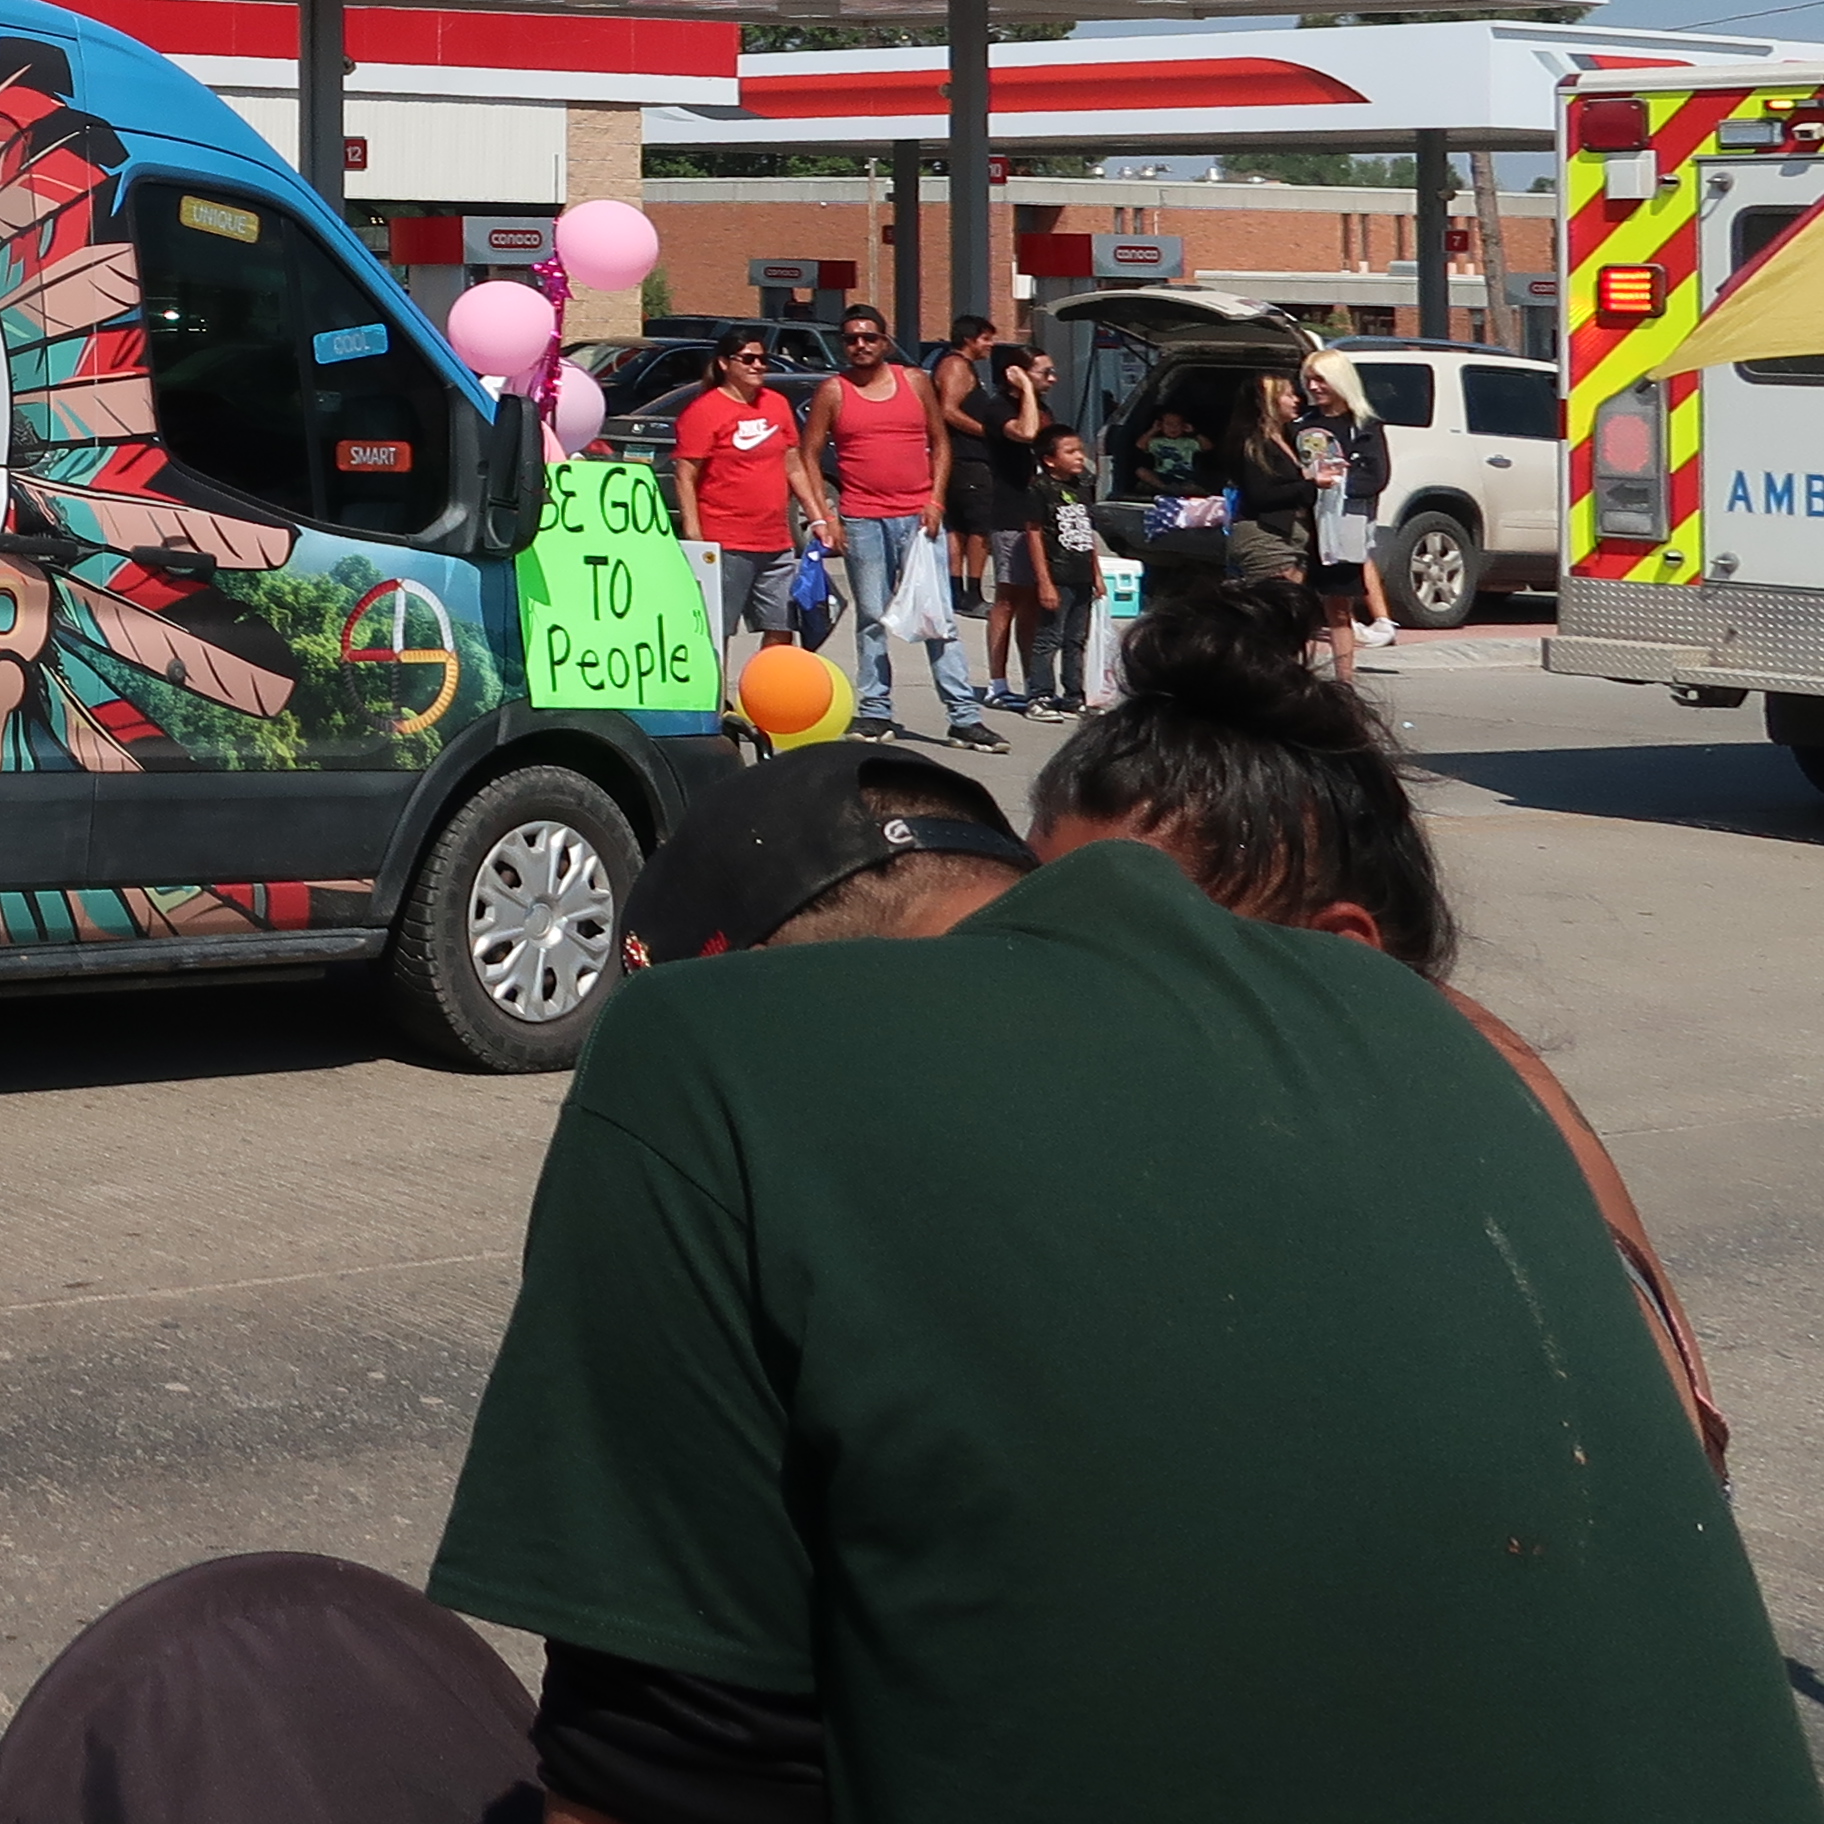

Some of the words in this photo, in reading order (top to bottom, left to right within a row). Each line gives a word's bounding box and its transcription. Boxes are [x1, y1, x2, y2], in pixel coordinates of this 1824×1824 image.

[346, 146, 362, 162] 12
[192, 204, 247, 234] UNIQUE
[1452, 236, 1461, 247] 7
[350, 446, 396, 465] SMART
[583, 555, 633, 620] TO
